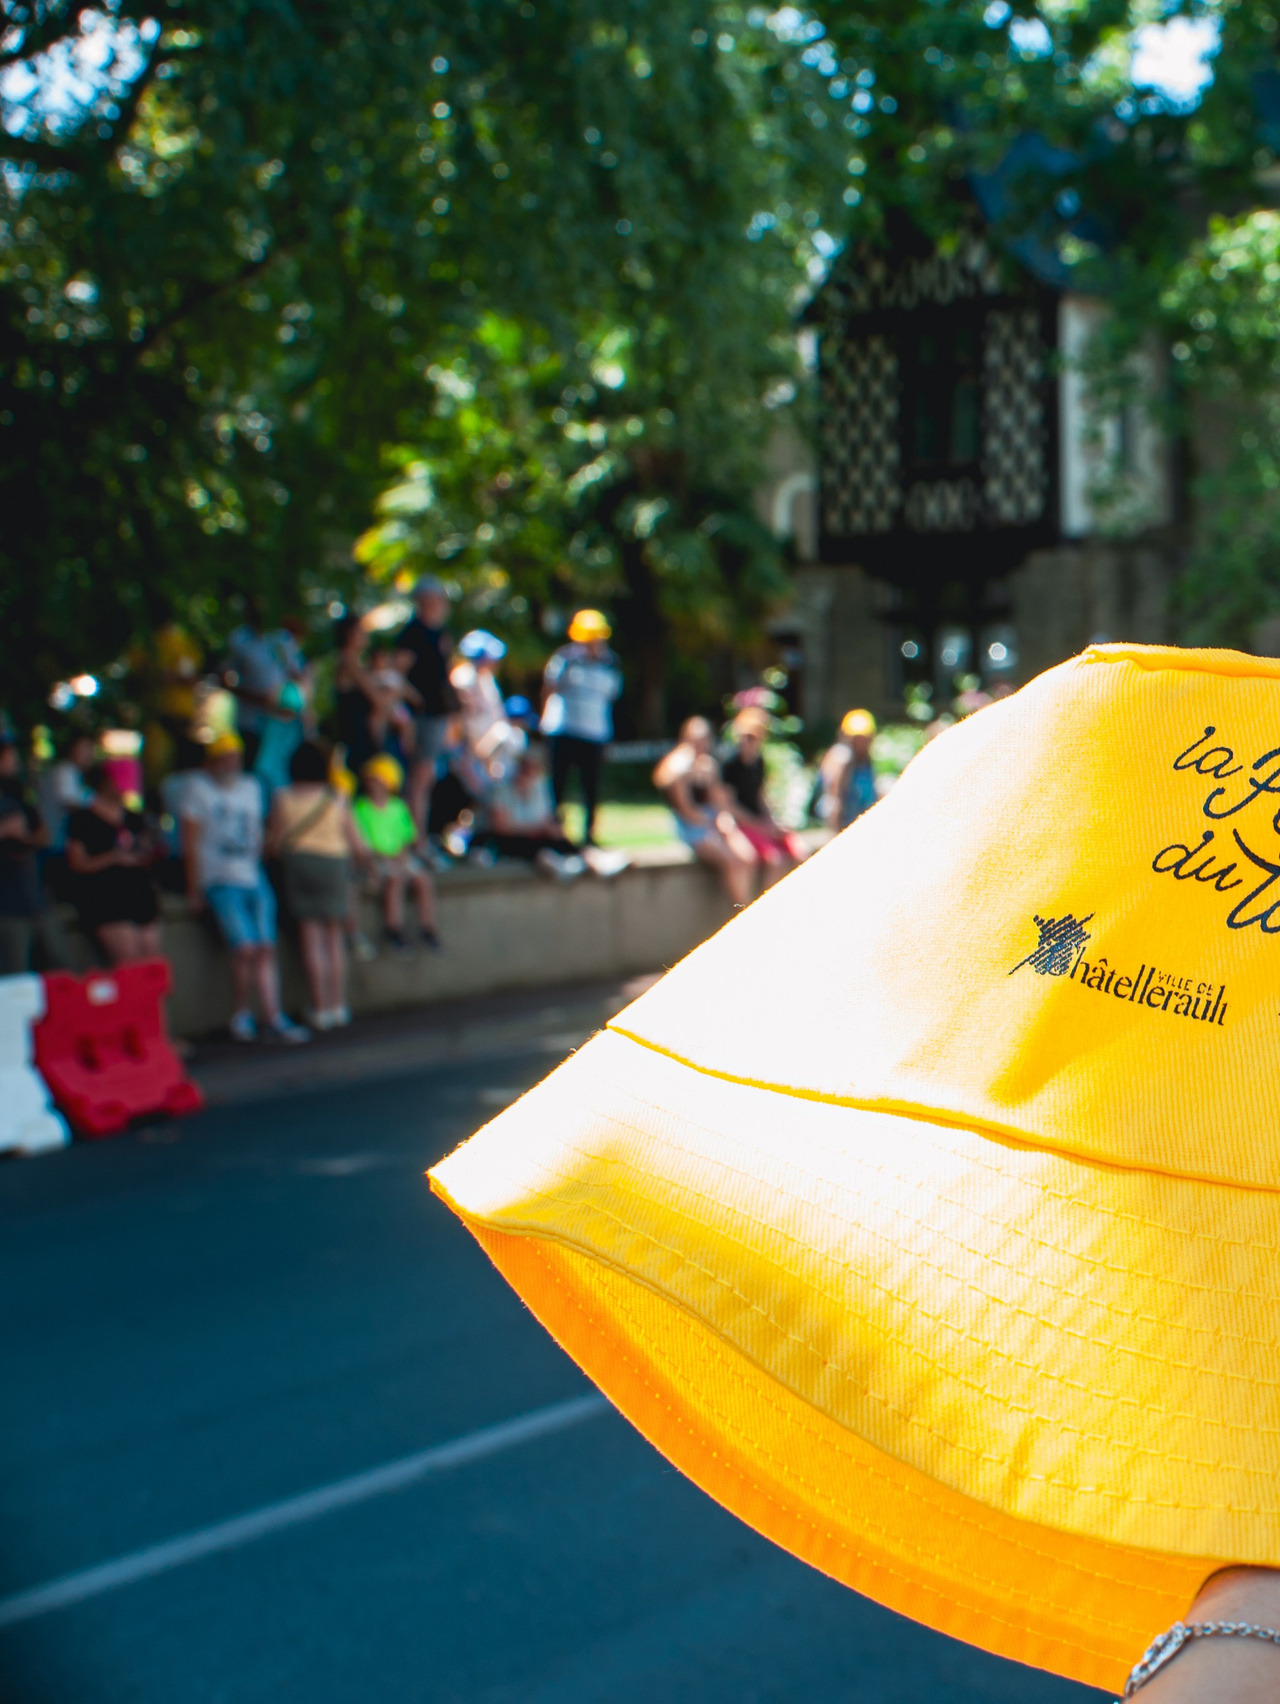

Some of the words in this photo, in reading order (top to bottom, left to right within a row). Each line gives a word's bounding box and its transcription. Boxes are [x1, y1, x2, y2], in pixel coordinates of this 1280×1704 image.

[1173, 725, 1243, 779] la
[1152, 830, 1243, 891] du
[1158, 970, 1193, 991] VILLE
